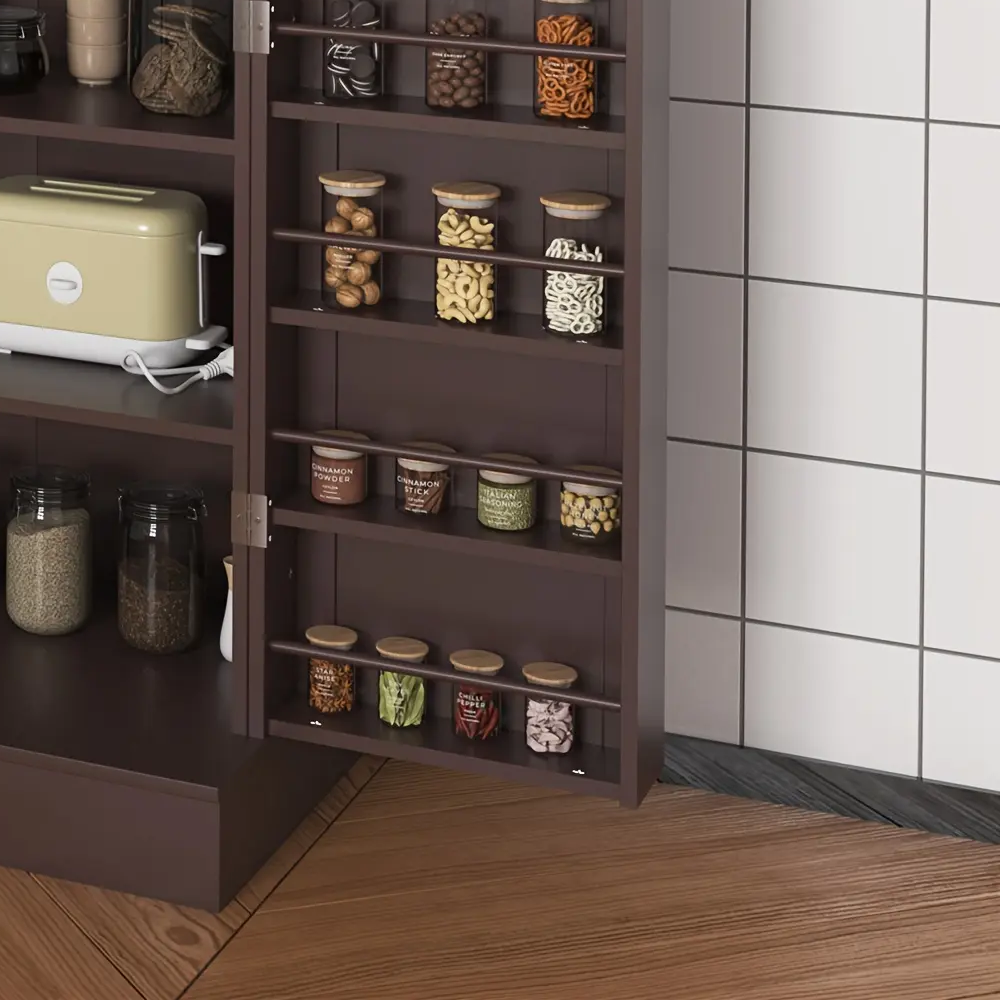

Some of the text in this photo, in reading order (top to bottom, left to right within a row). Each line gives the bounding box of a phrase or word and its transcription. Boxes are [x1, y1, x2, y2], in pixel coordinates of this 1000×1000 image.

[312, 462, 353, 475] CINNAMON
[314, 471, 351, 483] POWDER
[396, 475, 440, 488] CINNAMON
[404, 485, 430, 495] STICK
[483, 488, 517, 500] ITALIAN
[315, 667, 334, 675] STAR
[314, 673, 336, 682] ANISE
[458, 691, 483, 702] CHILLI
[456, 697, 486, 709] PEPPER
